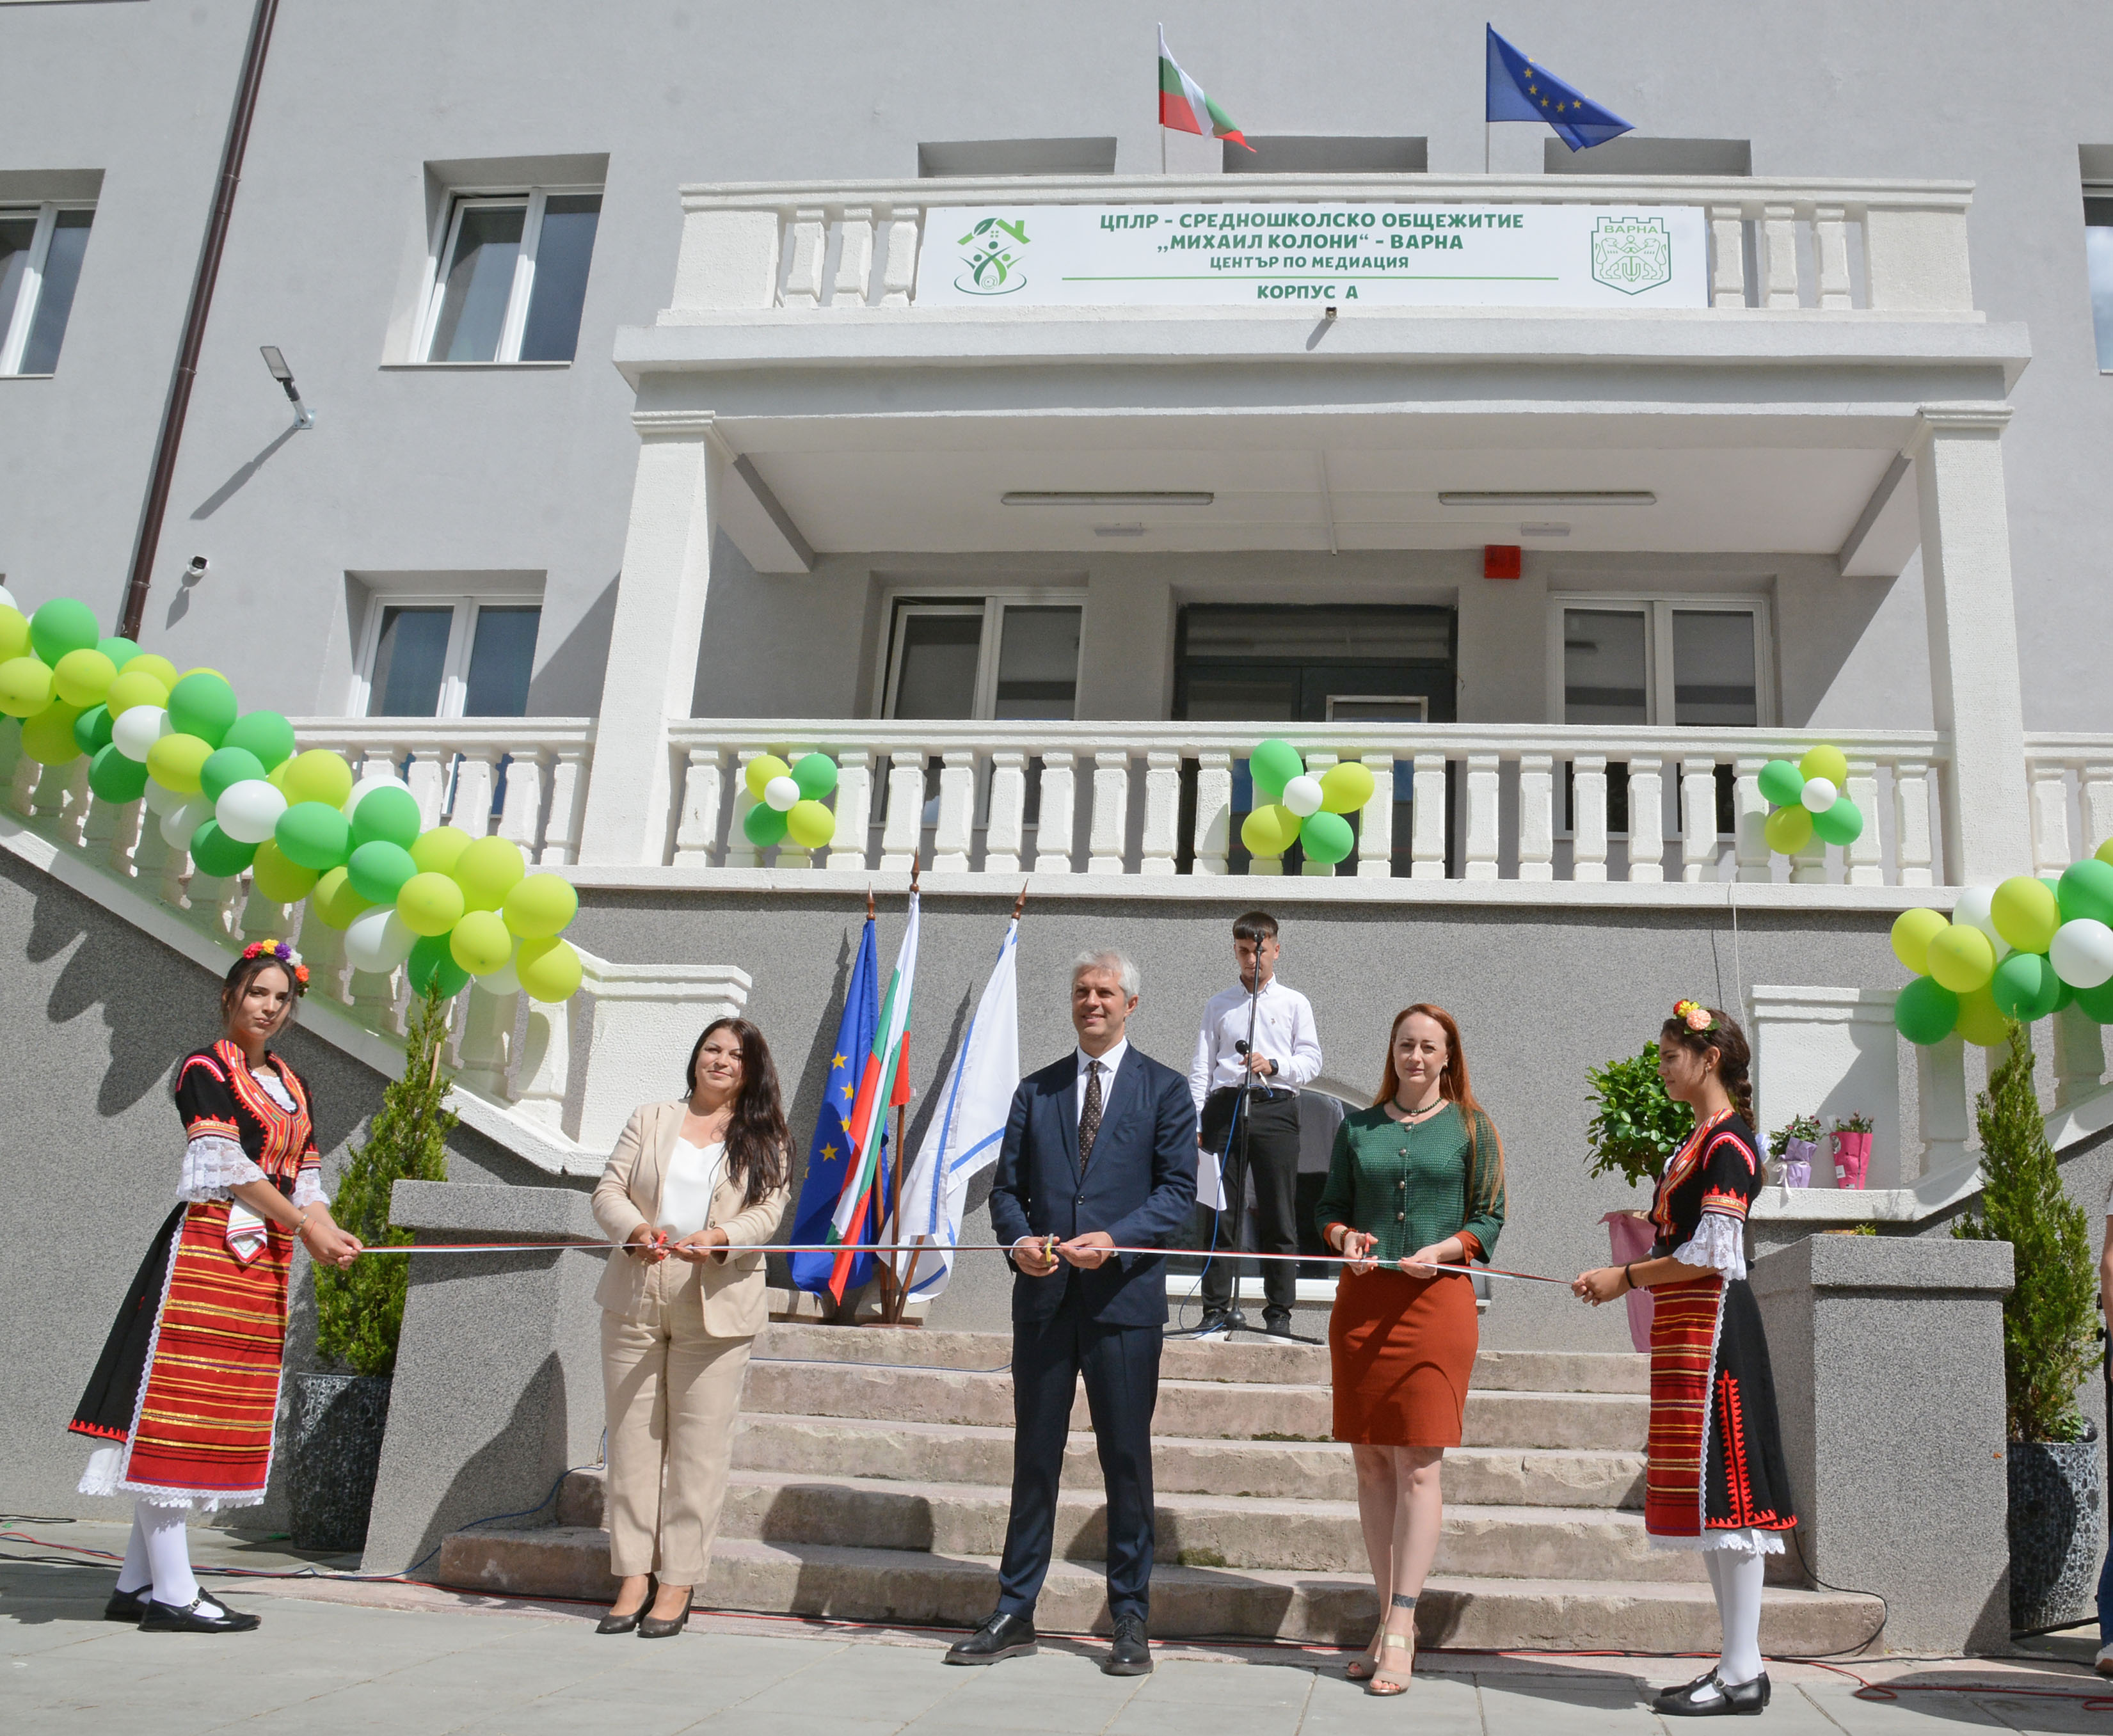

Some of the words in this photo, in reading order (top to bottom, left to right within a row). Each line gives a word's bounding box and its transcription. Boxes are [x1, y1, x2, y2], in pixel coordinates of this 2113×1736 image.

[1100, 214, 1159, 231] ЦПЛР
[1179, 212, 1376, 231] СРЕДНОШКОЛСКО
[1382, 212, 1524, 231] ОБЩЕЖИТИЕ
[1604, 225, 1659, 234] ВАРНА
[1390, 234, 1463, 250] ВАРНА
[1210, 256, 1279, 271] ЦЕНТЪР
[1283, 255, 1307, 268] ПО
[1311, 256, 1409, 271] МЕДИАЦИЯ
[1257, 285, 1336, 299] КОРПУС
[1346, 285, 1359, 299] А
